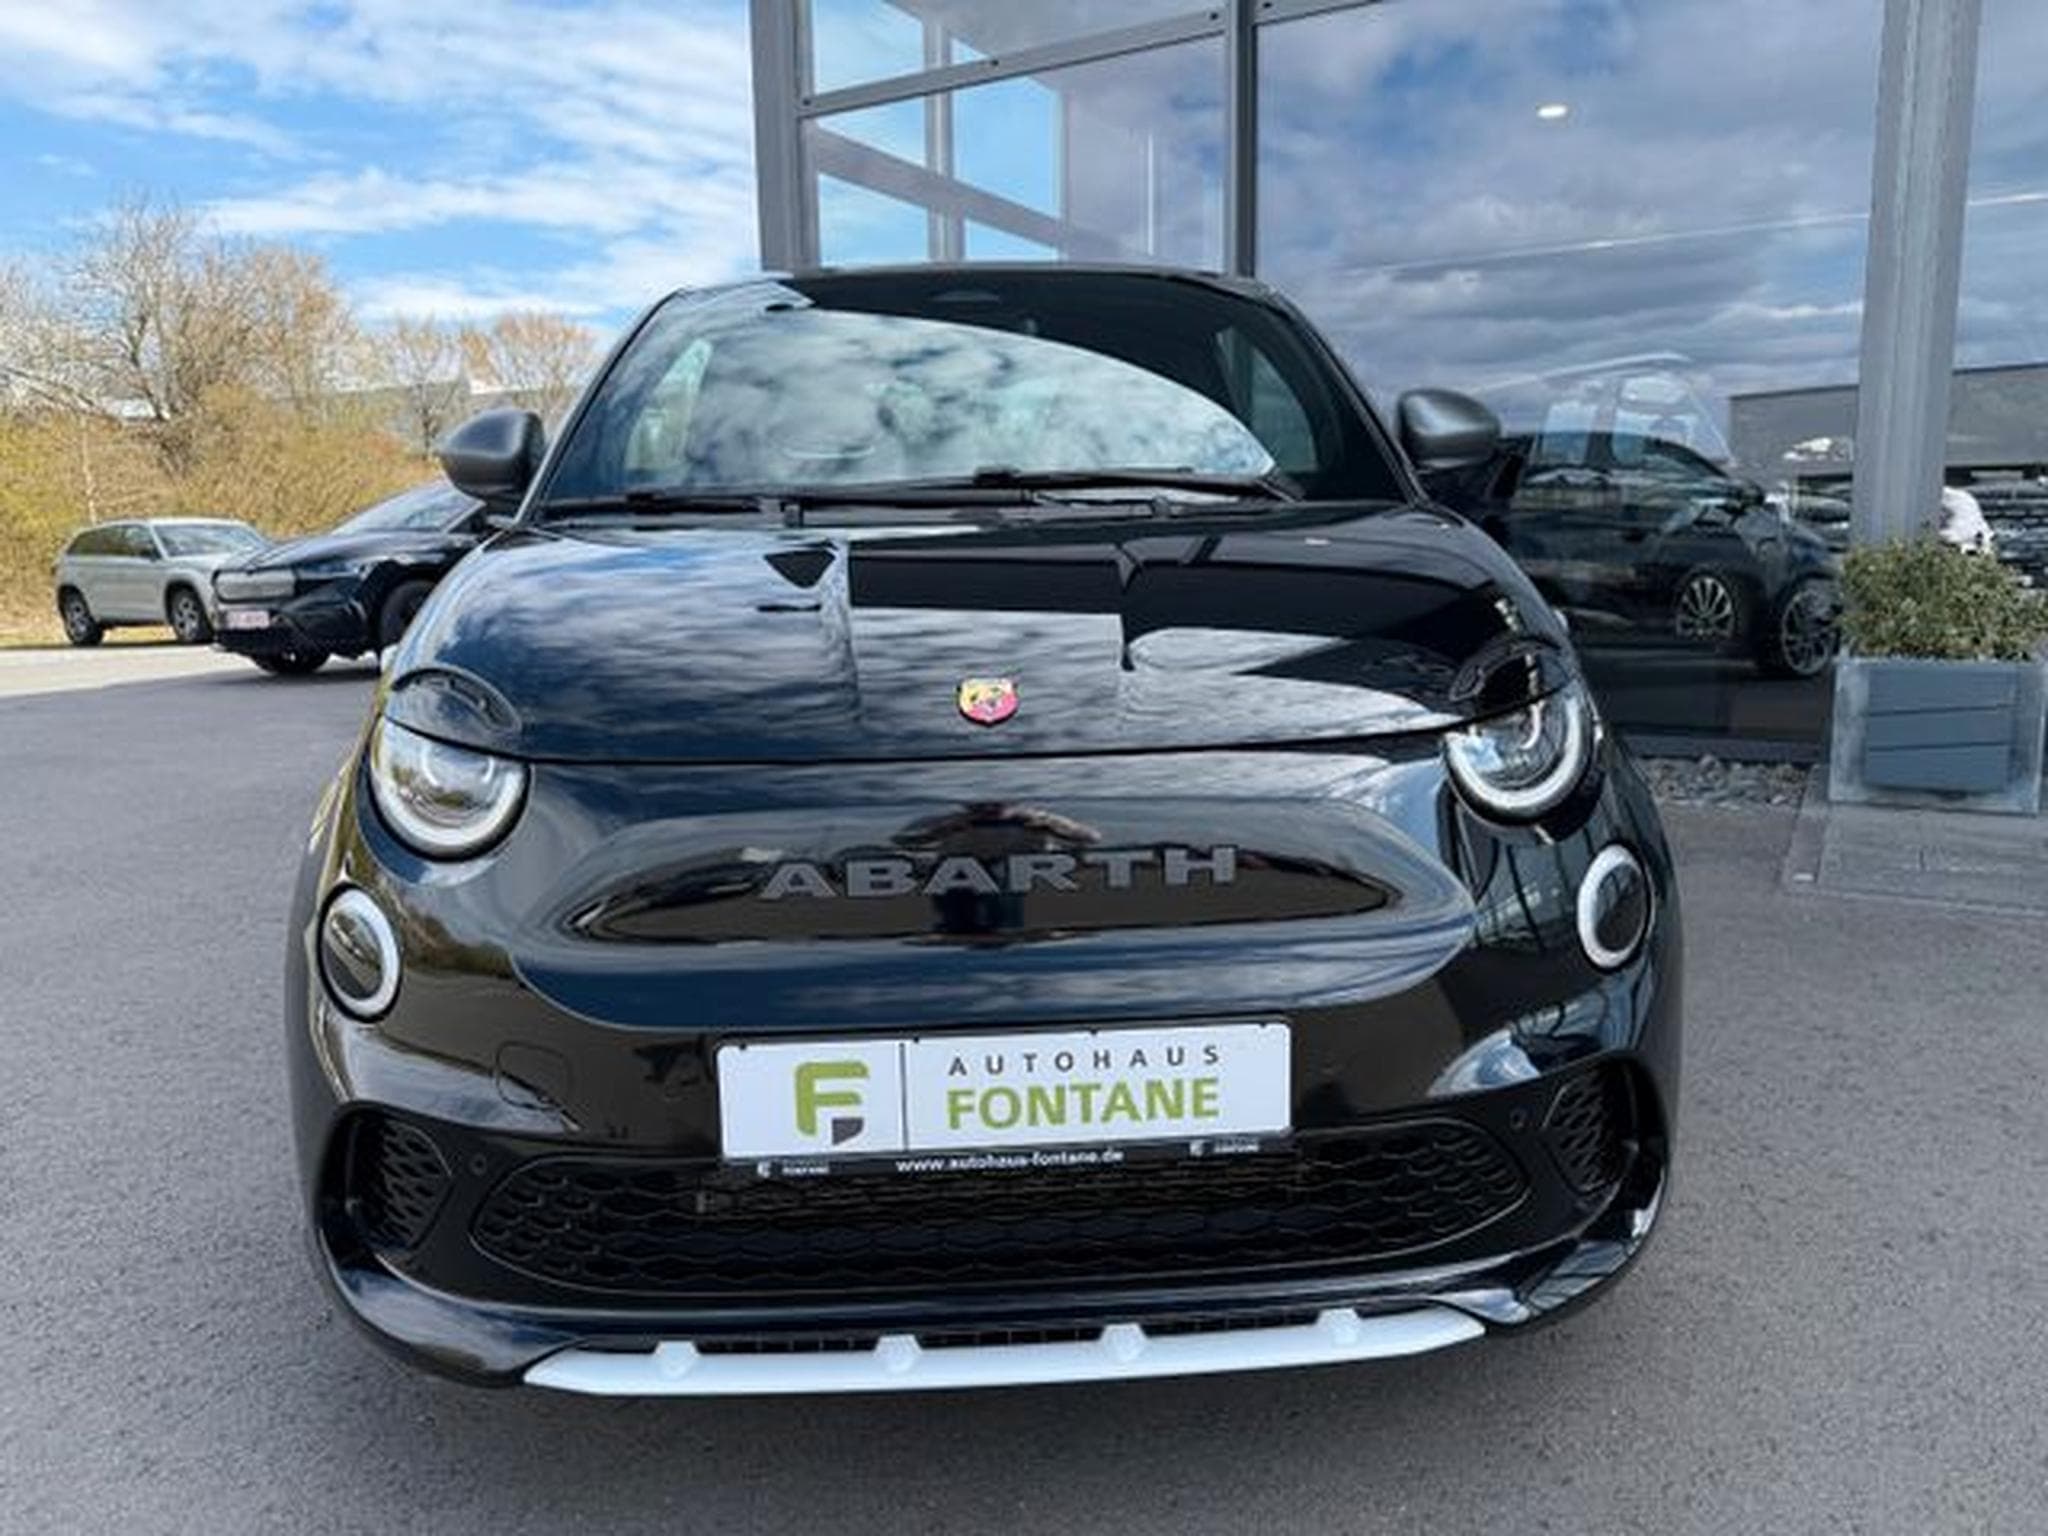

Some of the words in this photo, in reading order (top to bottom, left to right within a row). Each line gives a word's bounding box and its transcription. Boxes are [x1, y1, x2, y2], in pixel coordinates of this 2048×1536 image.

[759, 845, 1238, 898] ABARTH
[948, 1045, 1220, 1076] AUTOHAUS
[946, 1077, 1220, 1131] FONTANE
[896, 1146, 1125, 1172] www.autohaus-fontane.de
